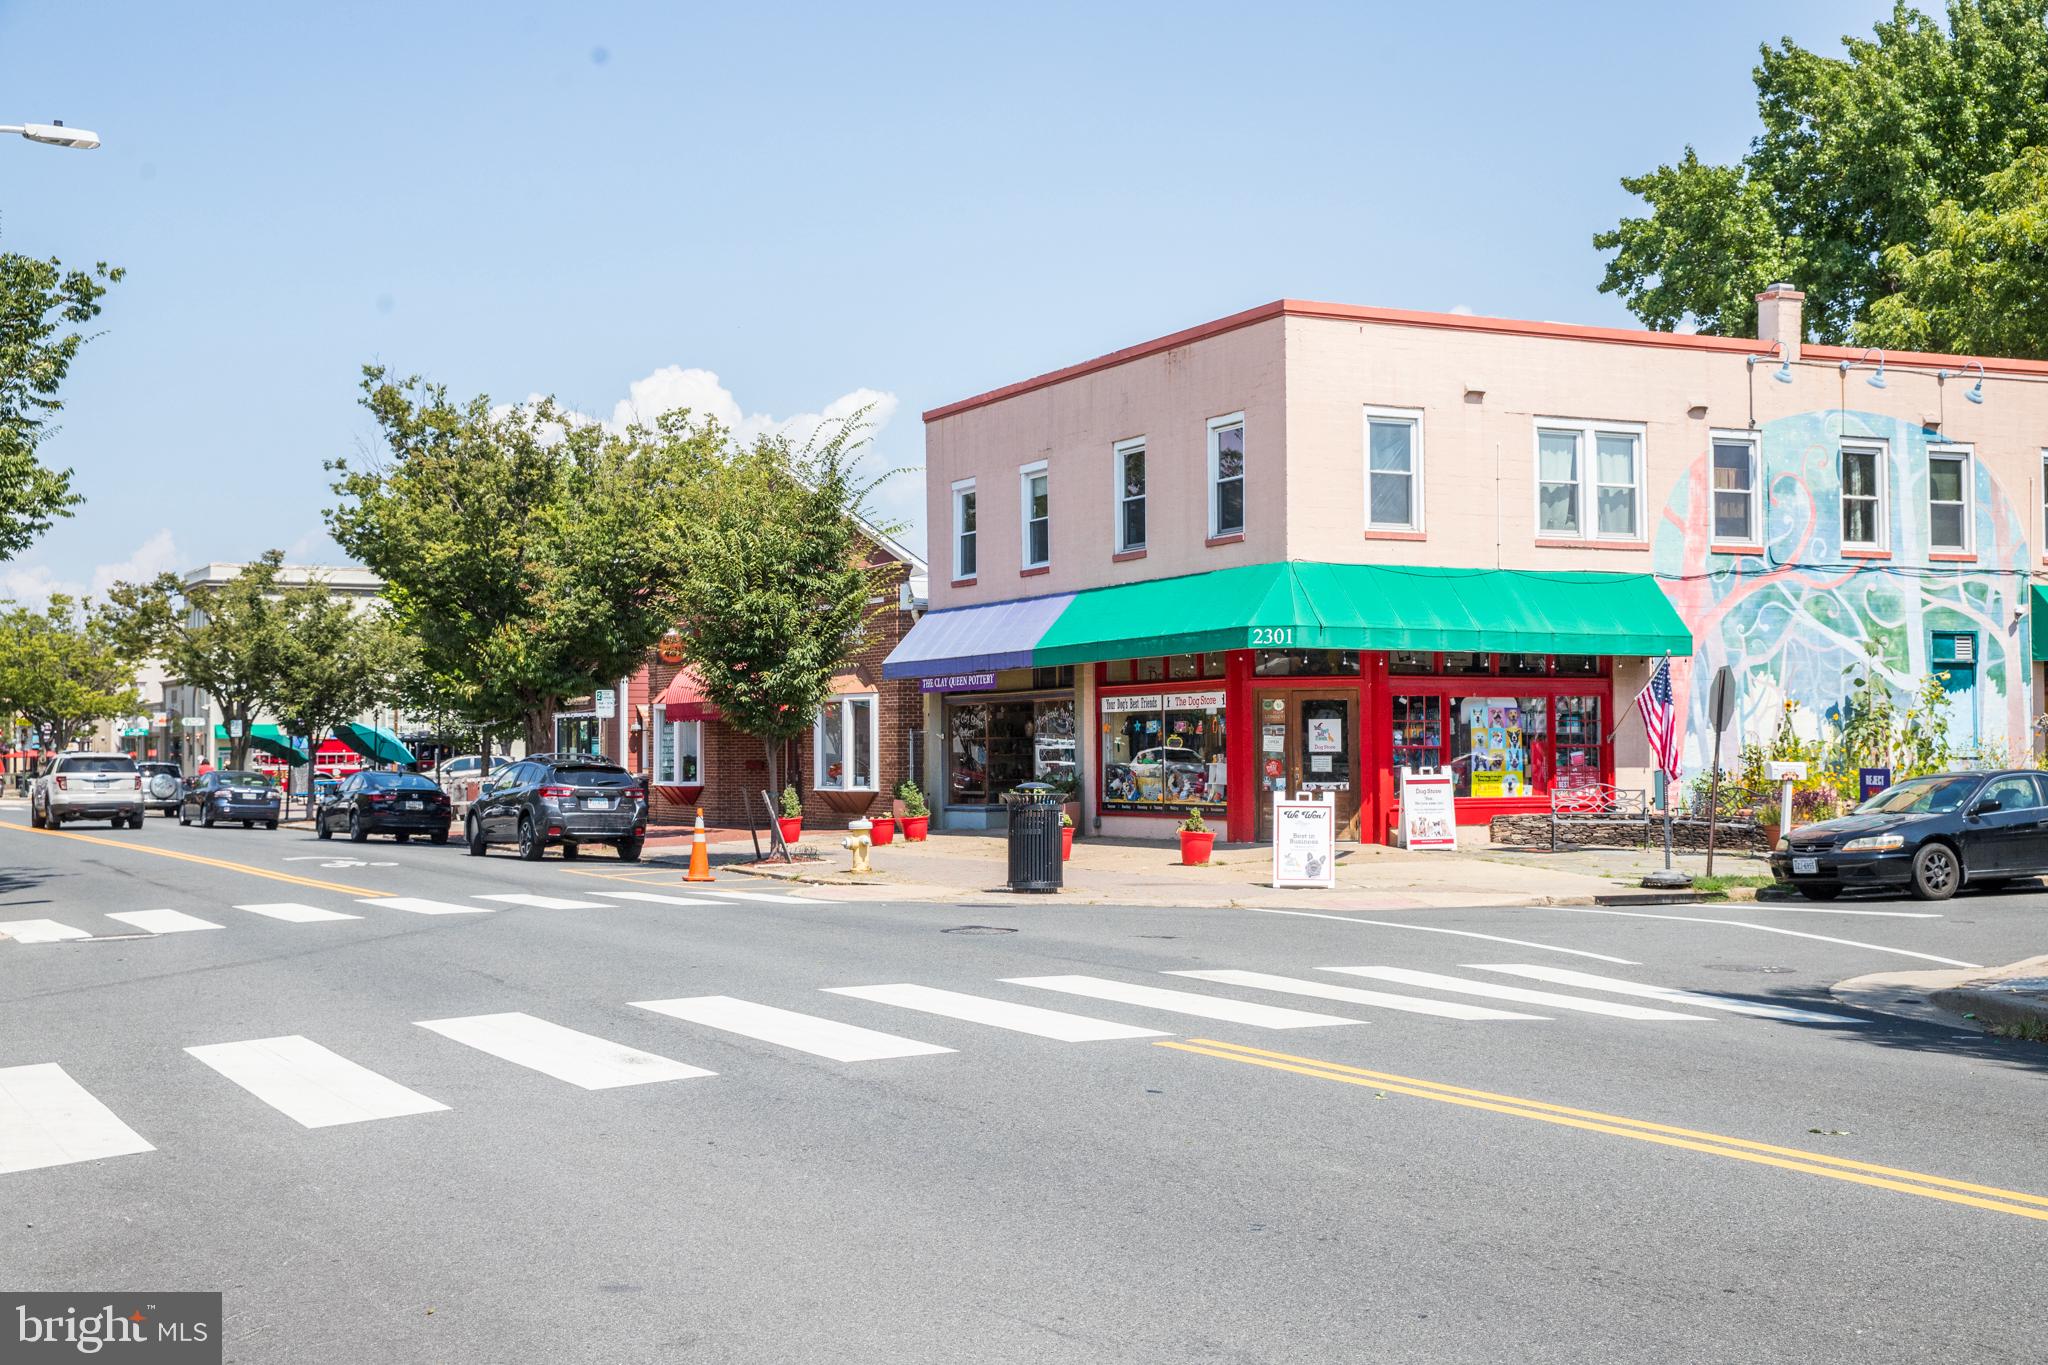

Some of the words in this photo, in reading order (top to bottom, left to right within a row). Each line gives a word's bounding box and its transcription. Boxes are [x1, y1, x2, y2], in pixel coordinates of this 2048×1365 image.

[1252, 628, 1293, 645] 2301
[922, 678, 934, 688] THE
[934, 677, 949, 688] CLAY
[948, 675, 968, 688] QUEEN
[968, 673, 995, 685] POTTERY
[1106, 699, 1116, 709] Your
[1117, 698, 1128, 711] Dog's
[1130, 698, 1140, 709] Best
[1141, 697, 1158, 708] Friends
[1175, 697, 1187, 706] The
[1188, 696, 1200, 708] Dog
[1200, 695, 1217, 704] Store
[1865, 775, 1884, 785] REJECT
[1284, 810, 1299, 819] We
[1301, 810, 1326, 819] Won!
